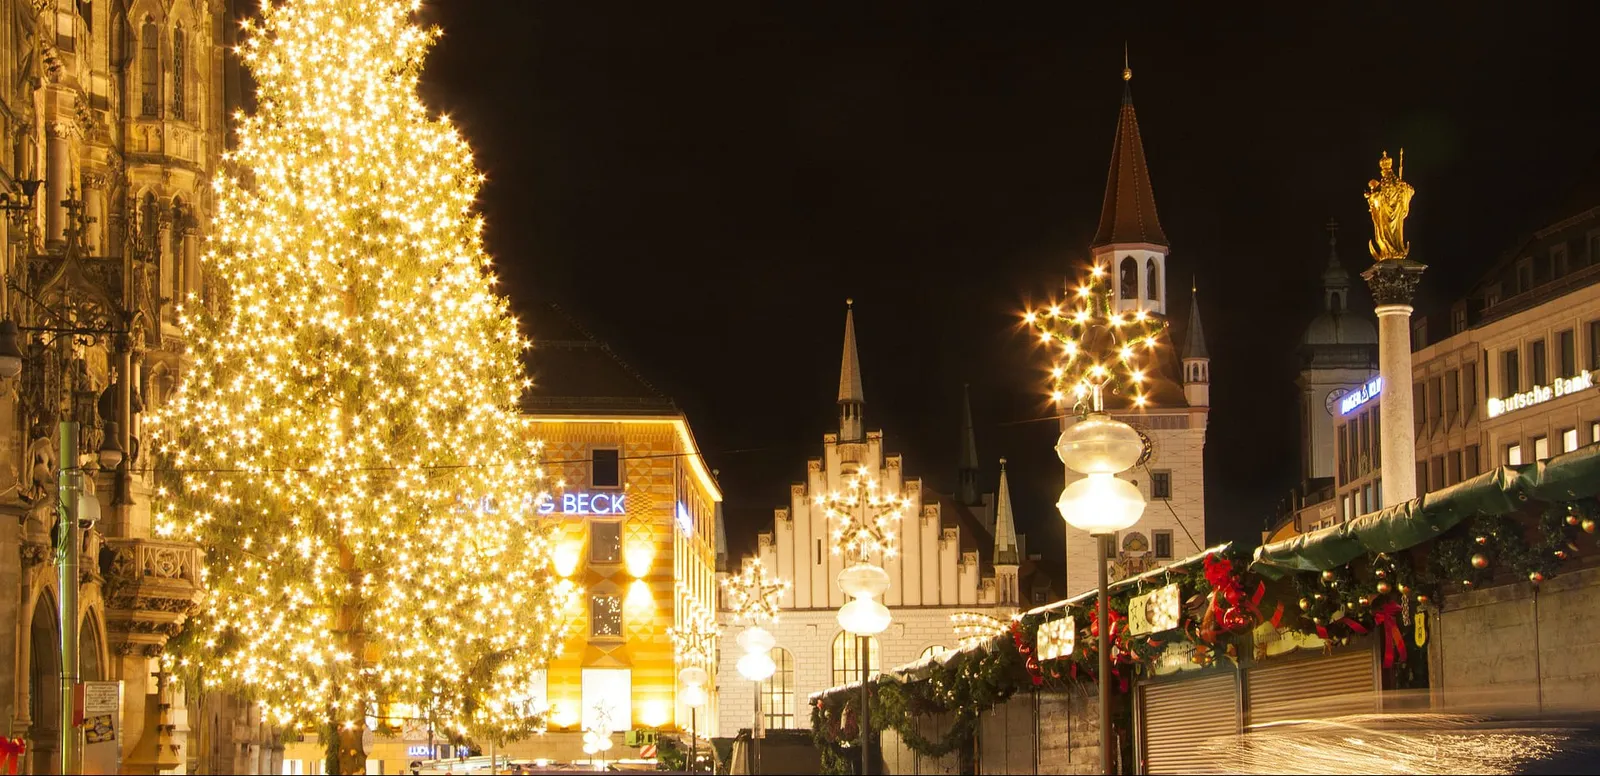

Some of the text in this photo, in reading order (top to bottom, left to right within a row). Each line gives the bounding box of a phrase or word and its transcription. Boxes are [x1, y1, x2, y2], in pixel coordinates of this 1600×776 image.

[1488, 369, 1593, 418] Deutsche Bank
[563, 493, 626, 515] BECK
